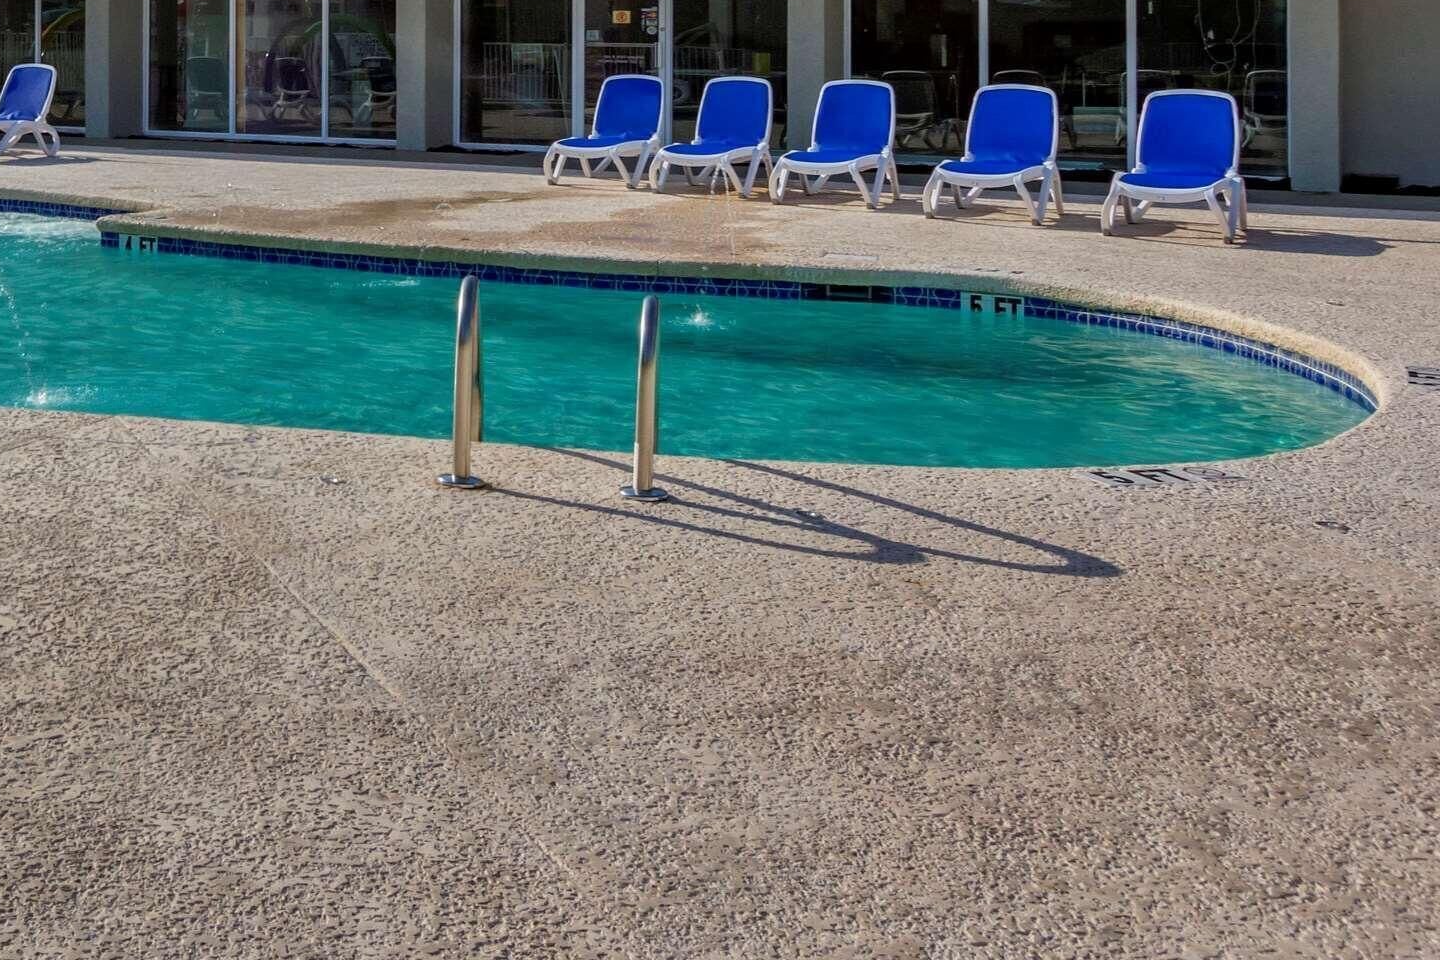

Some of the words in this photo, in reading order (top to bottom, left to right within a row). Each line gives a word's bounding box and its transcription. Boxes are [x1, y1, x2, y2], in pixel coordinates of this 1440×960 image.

[139, 236, 156, 251] FT
[994, 296, 1022, 316] FT
[1090, 471, 1135, 484] 5
[1126, 468, 1191, 483] FT
